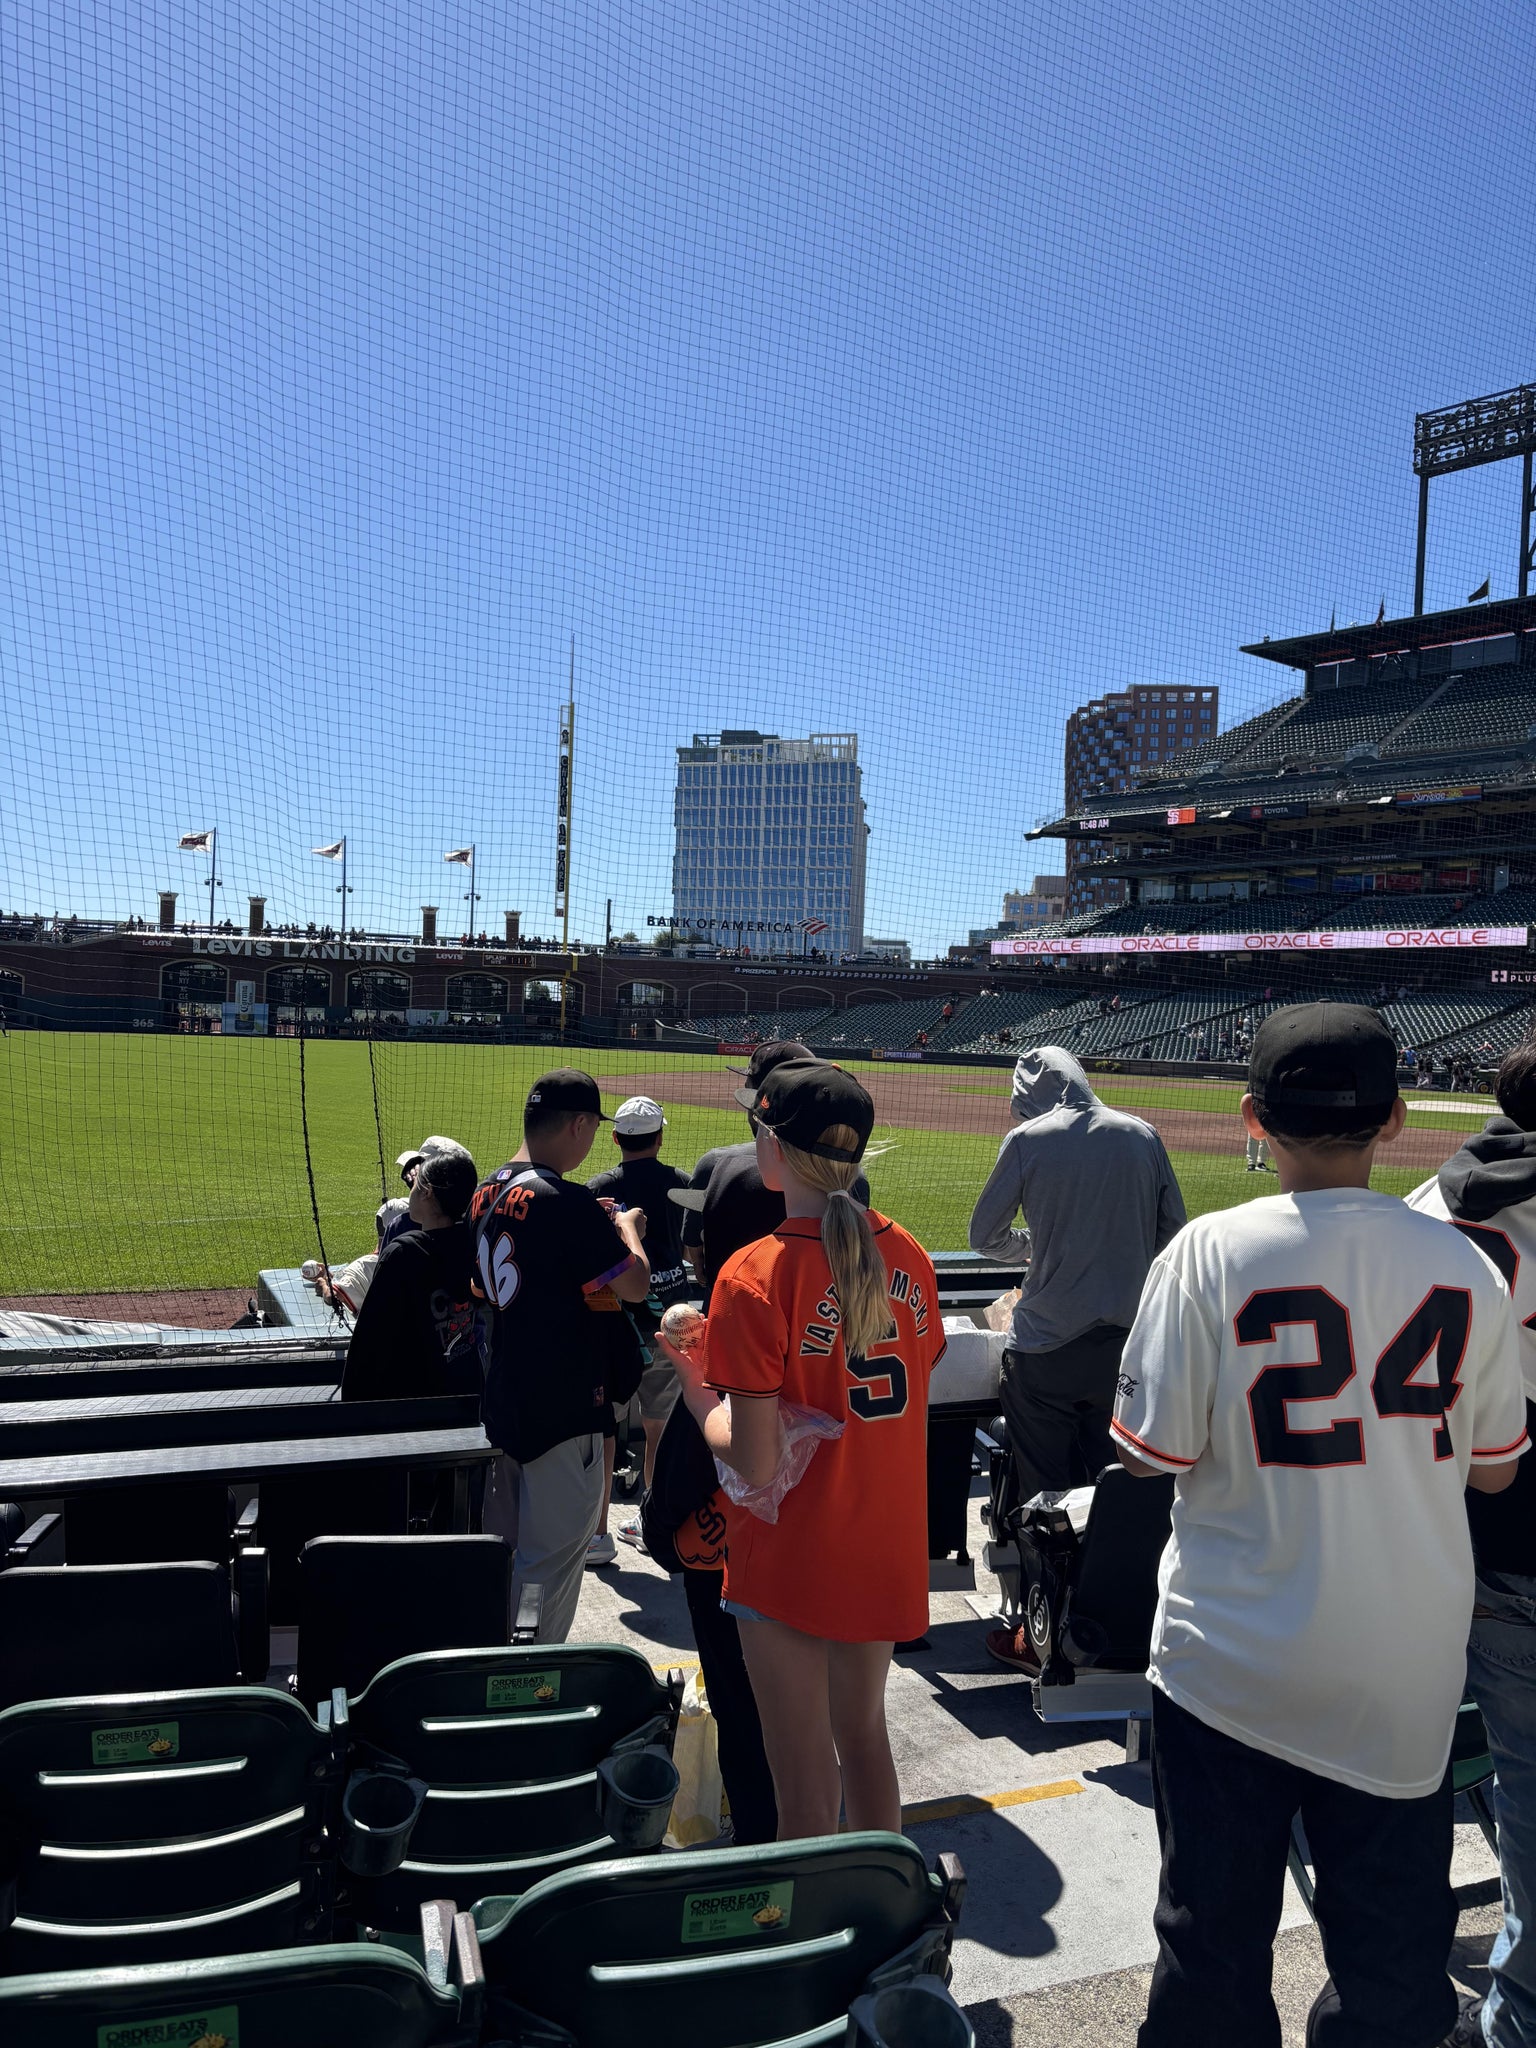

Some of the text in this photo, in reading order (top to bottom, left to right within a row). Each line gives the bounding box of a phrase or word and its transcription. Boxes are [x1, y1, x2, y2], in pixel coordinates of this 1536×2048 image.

[1264, 807, 1288, 815] TOYOTA
[1098, 818, 1109, 829] AM
[647, 915, 793, 934] BANK OF AMERICA
[1013, 940, 1082, 953] ORACLE
[1121, 937, 1200, 951] ORACLE
[1245, 933, 1335, 949] ORACLE
[1385, 930, 1489, 947] ORACLE
[284, 942, 416, 963] LANDING
[1510, 974, 1536, 983] PLUS
[132, 1018, 155, 1028] 365
[477, 1231, 522, 1311] 16
[800, 1267, 929, 1357] YASTMSKI
[845, 1317, 910, 1422] 5
[1233, 1284, 1473, 1467] 24
[96, 1729, 160, 1741] ORDER EATS
[690, 1891, 770, 1909] ORDER EATS
[690, 1907, 718, 1917] FROM
[720, 1903, 745, 1913] YOUR
[106, 2018, 209, 2042] ORDER EATS
